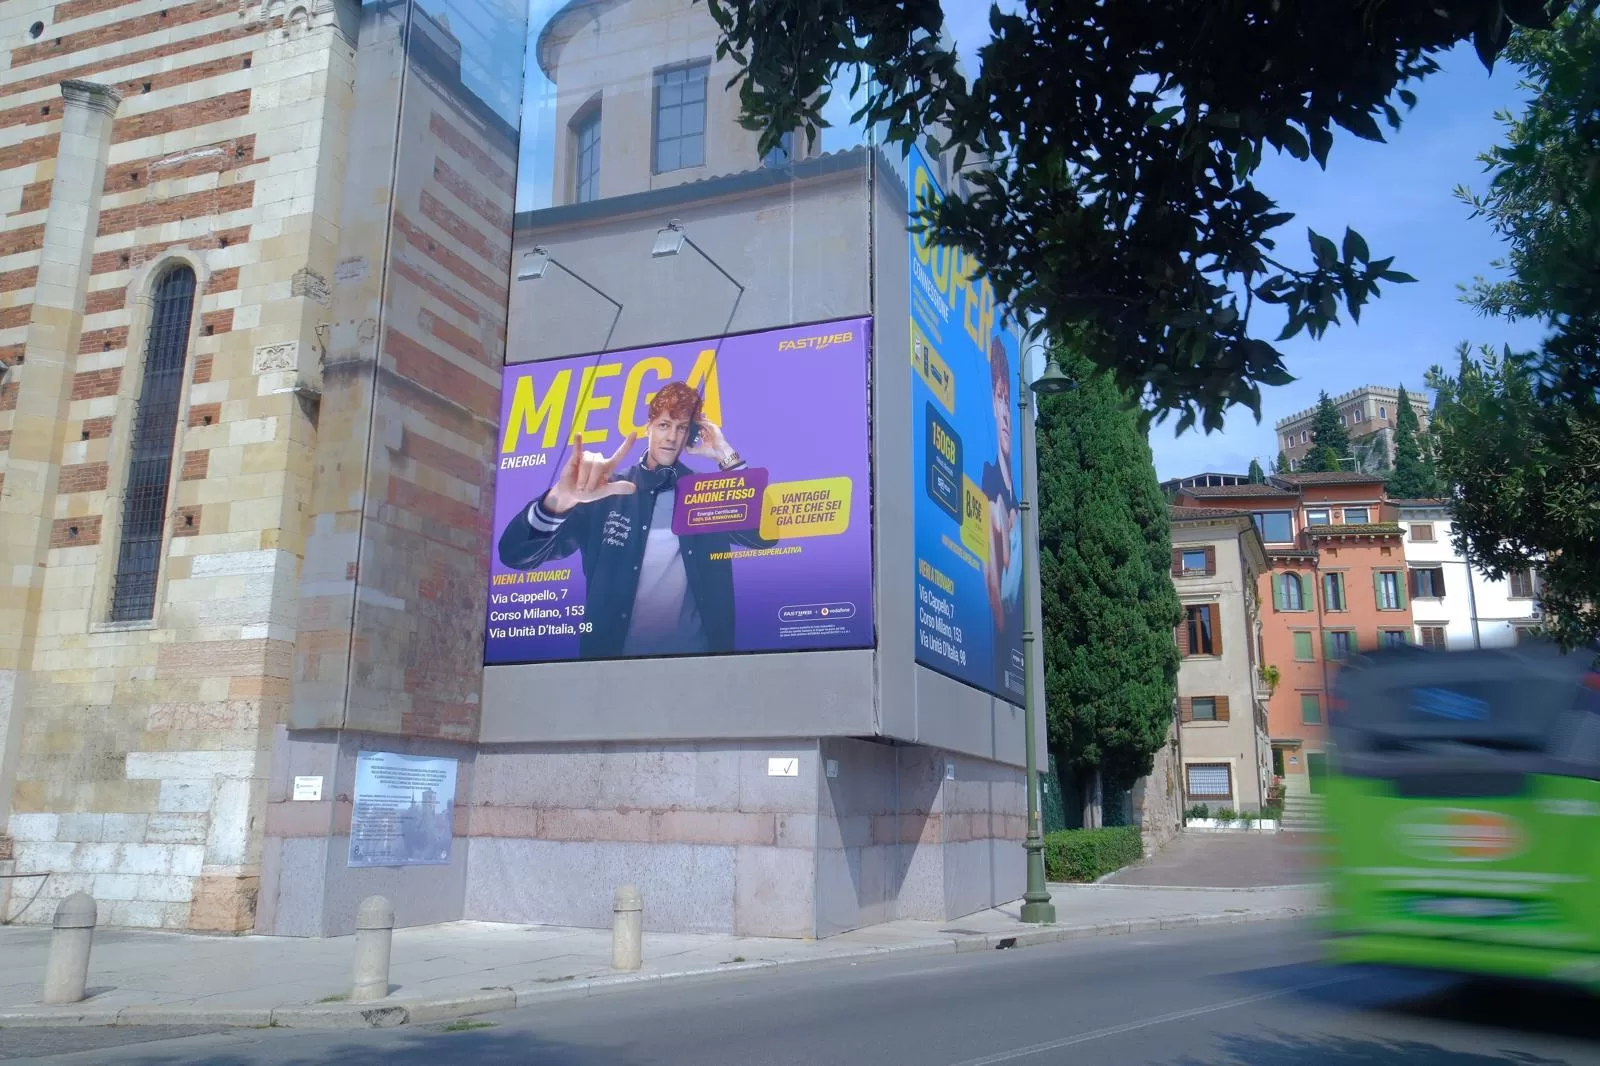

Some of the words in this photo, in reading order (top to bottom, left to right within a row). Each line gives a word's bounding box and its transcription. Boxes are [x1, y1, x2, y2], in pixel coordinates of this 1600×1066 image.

[913, 257, 949, 324] CONNESSIONE
[778, 332, 853, 352] FASTWEB
[501, 349, 722, 454] MEGA
[932, 421, 956, 465] 150GB
[500, 453, 546, 470] ENERGIA
[694, 478, 737, 492] OFFERTE
[737, 477, 745, 487] A
[684, 491, 725, 505] CANONE
[726, 488, 755, 501] FISSO
[782, 490, 831, 504] VANTAGGI
[770, 506, 789, 516] PER
[791, 504, 802, 514] TE
[804, 502, 824, 512] CHE
[825, 500, 842, 511] SEI
[795, 512, 836, 525] CLIENTE
[710, 552, 724, 560] VIVI
[758, 546, 802, 557] SUPERLATIVA
[492, 573, 517, 586] VIENI
[517, 573, 525, 584] A
[526, 569, 571, 583] TROVARCI
[491, 593, 508, 604] Via
[510, 590, 559, 604] Cappello,
[561, 589, 568, 599] 7
[918, 584, 928, 603] Via
[928, 590, 951, 620] Cappello,
[490, 611, 521, 622] Corso
[523, 608, 562, 620] Milano,
[565, 605, 585, 616] 153
[489, 628, 506, 639] Via
[508, 626, 536, 637] Unità
[579, 622, 593, 633] 98
[919, 607, 935, 629] Corso
[935, 616, 953, 641] Milano,
[953, 626, 962, 643] 153
[919, 629, 929, 648] Via
